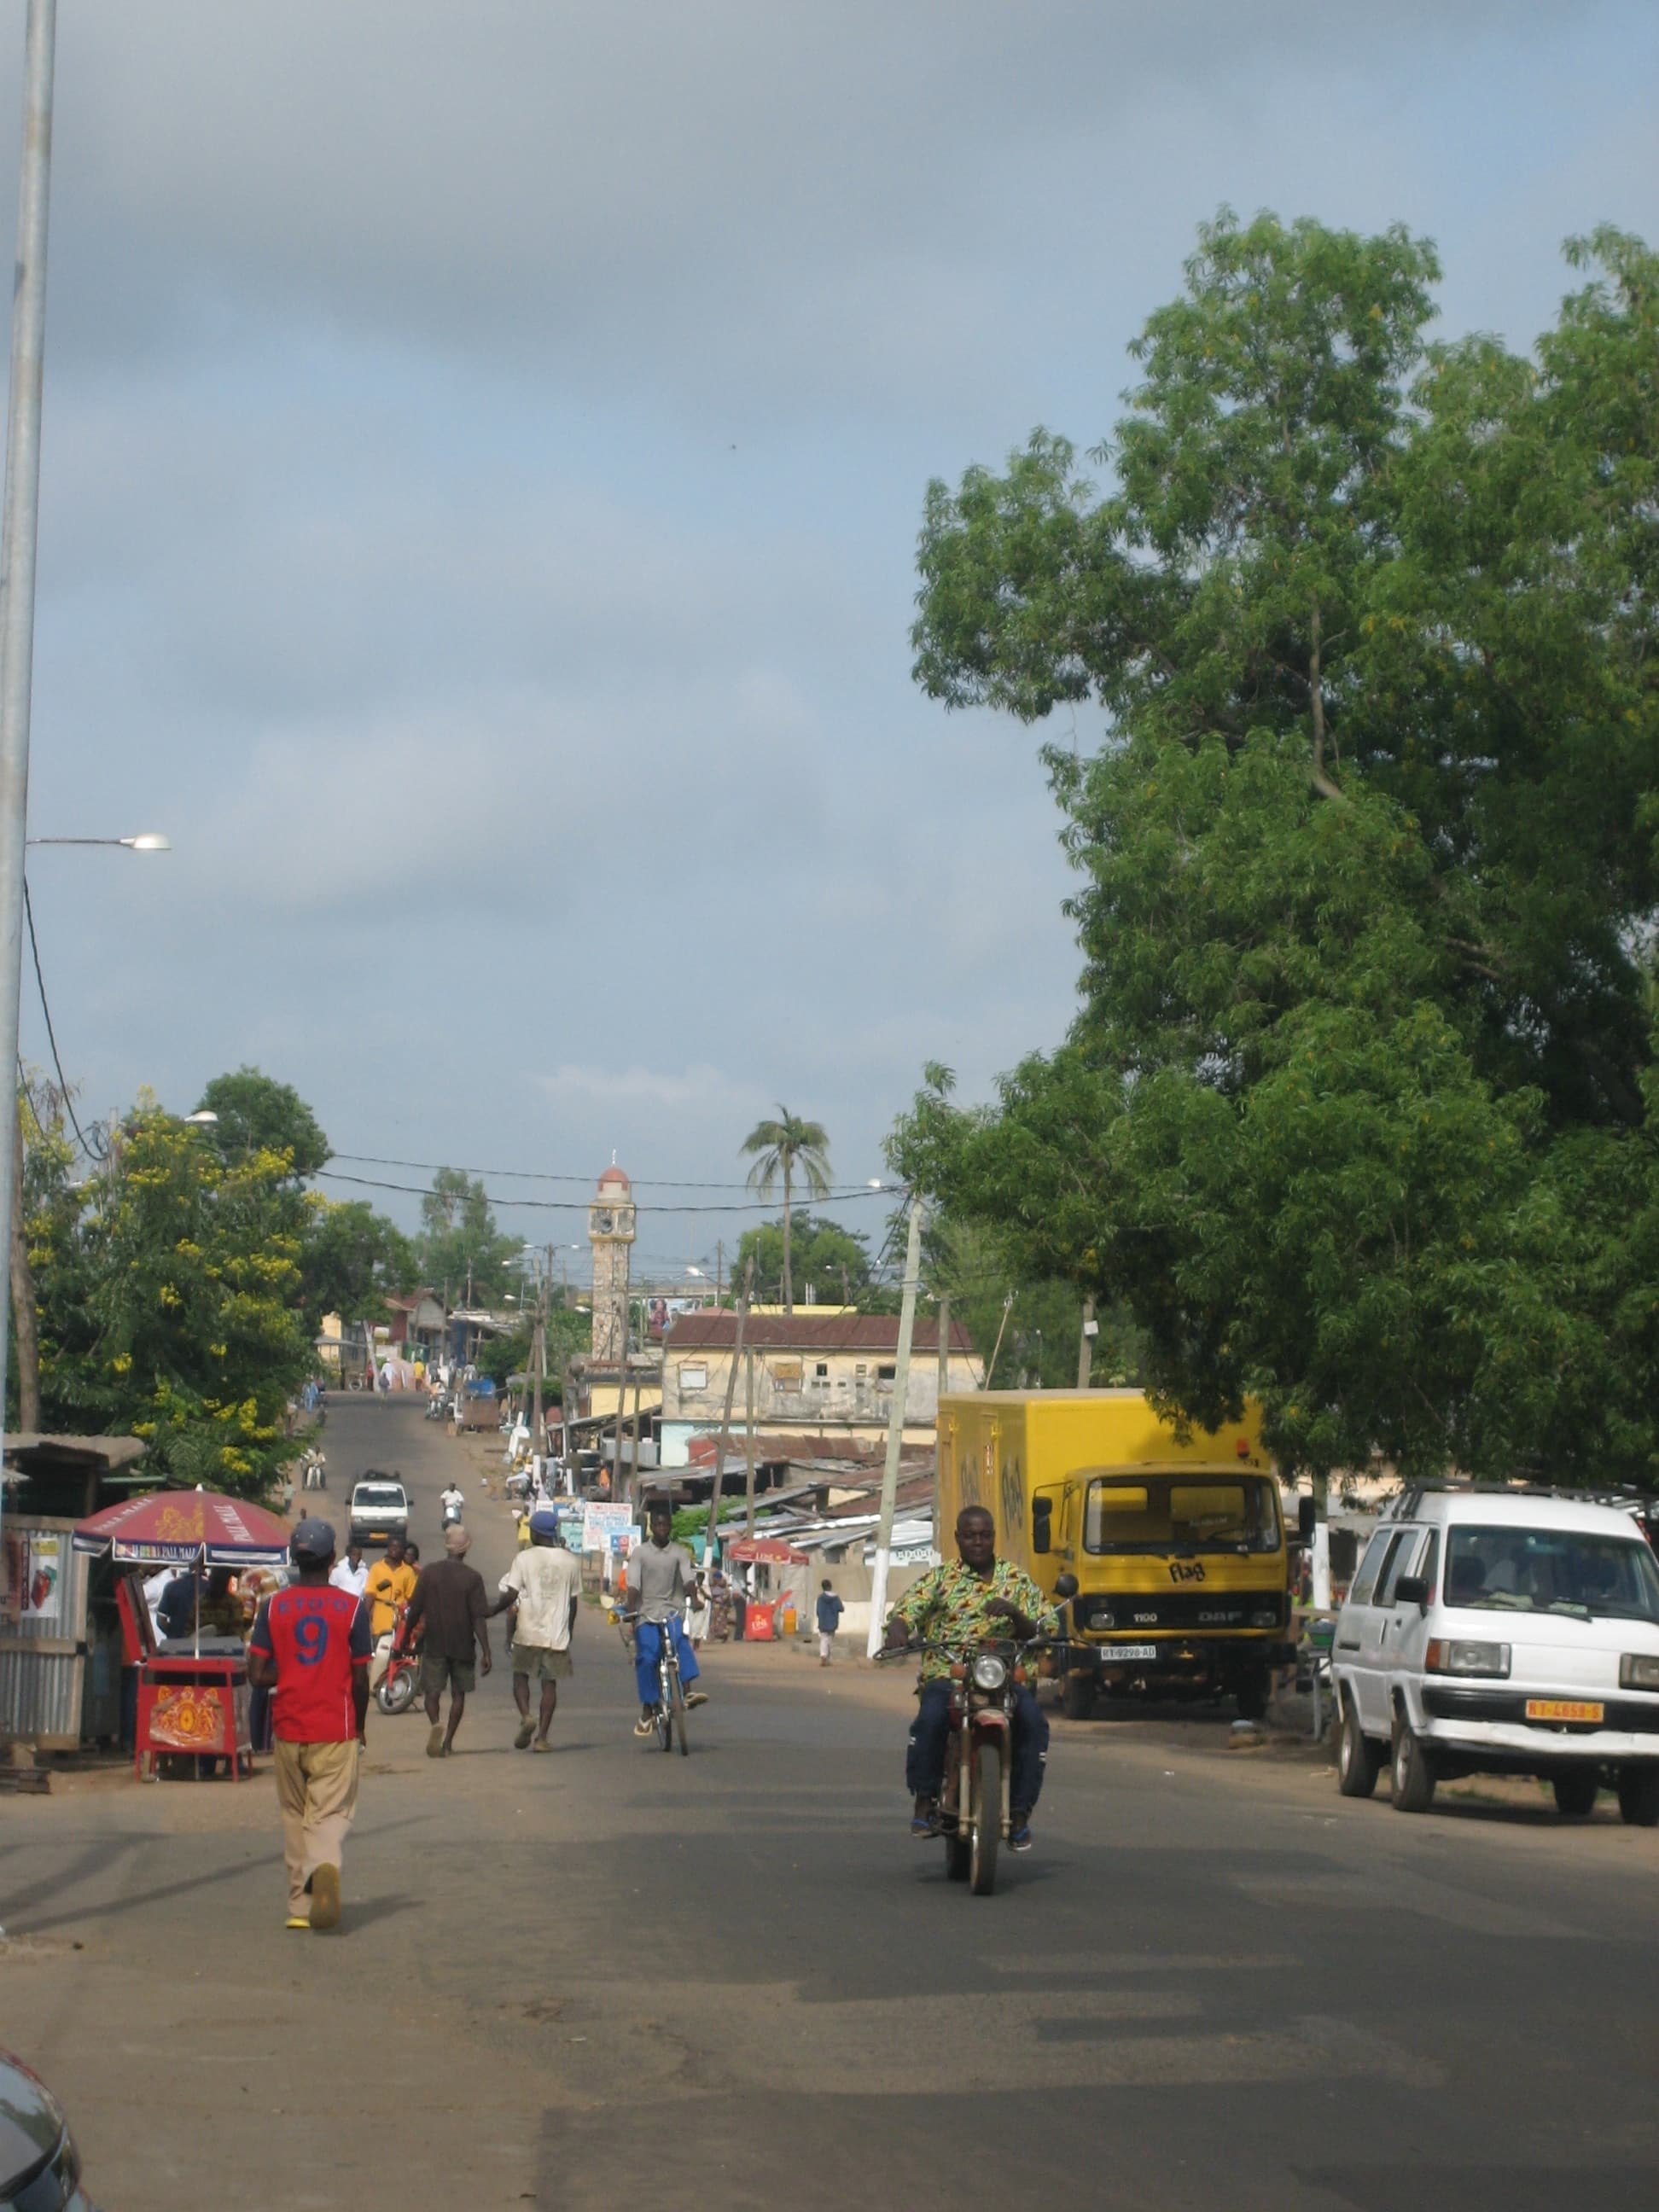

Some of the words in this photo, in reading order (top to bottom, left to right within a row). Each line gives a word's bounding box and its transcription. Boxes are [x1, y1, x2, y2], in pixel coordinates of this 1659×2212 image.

[162, 1545, 178, 1558] PALL
[178, 1546, 195, 1559] MALL
[1133, 1612, 1157, 1622] 1100
[1198, 1611, 1242, 1621] DAF
[294, 1615, 329, 1667] 9
